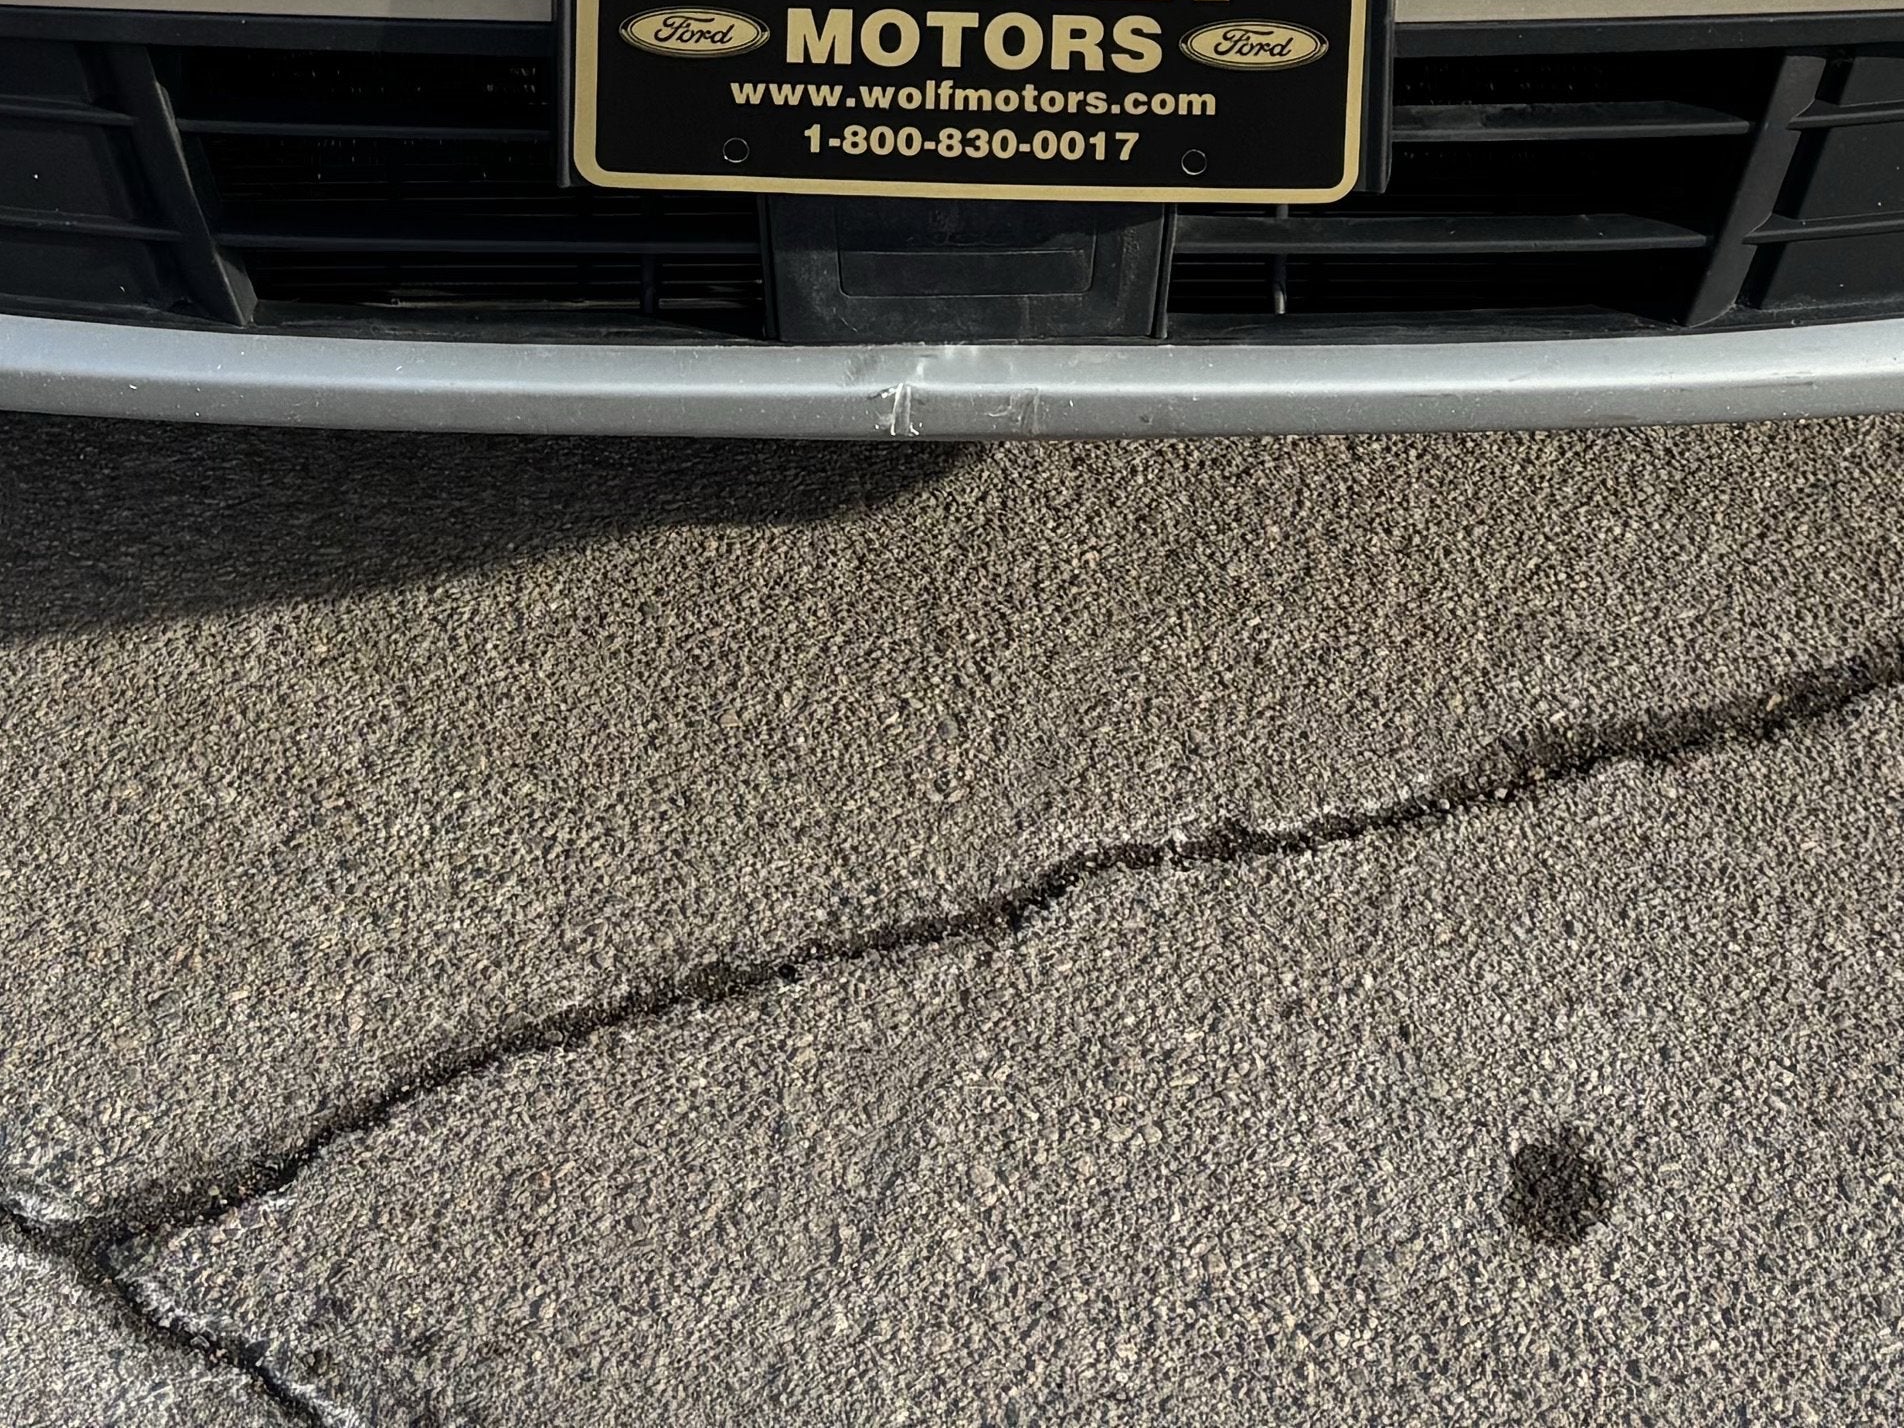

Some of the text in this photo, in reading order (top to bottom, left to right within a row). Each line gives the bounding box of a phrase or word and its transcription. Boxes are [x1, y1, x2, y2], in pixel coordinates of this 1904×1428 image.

[653, 8, 1295, 74] Ford MOTORS Ford
[730, 80, 1216, 116] www.wolfmotors.com
[804, 124, 1140, 161] 1-800-830-0017
